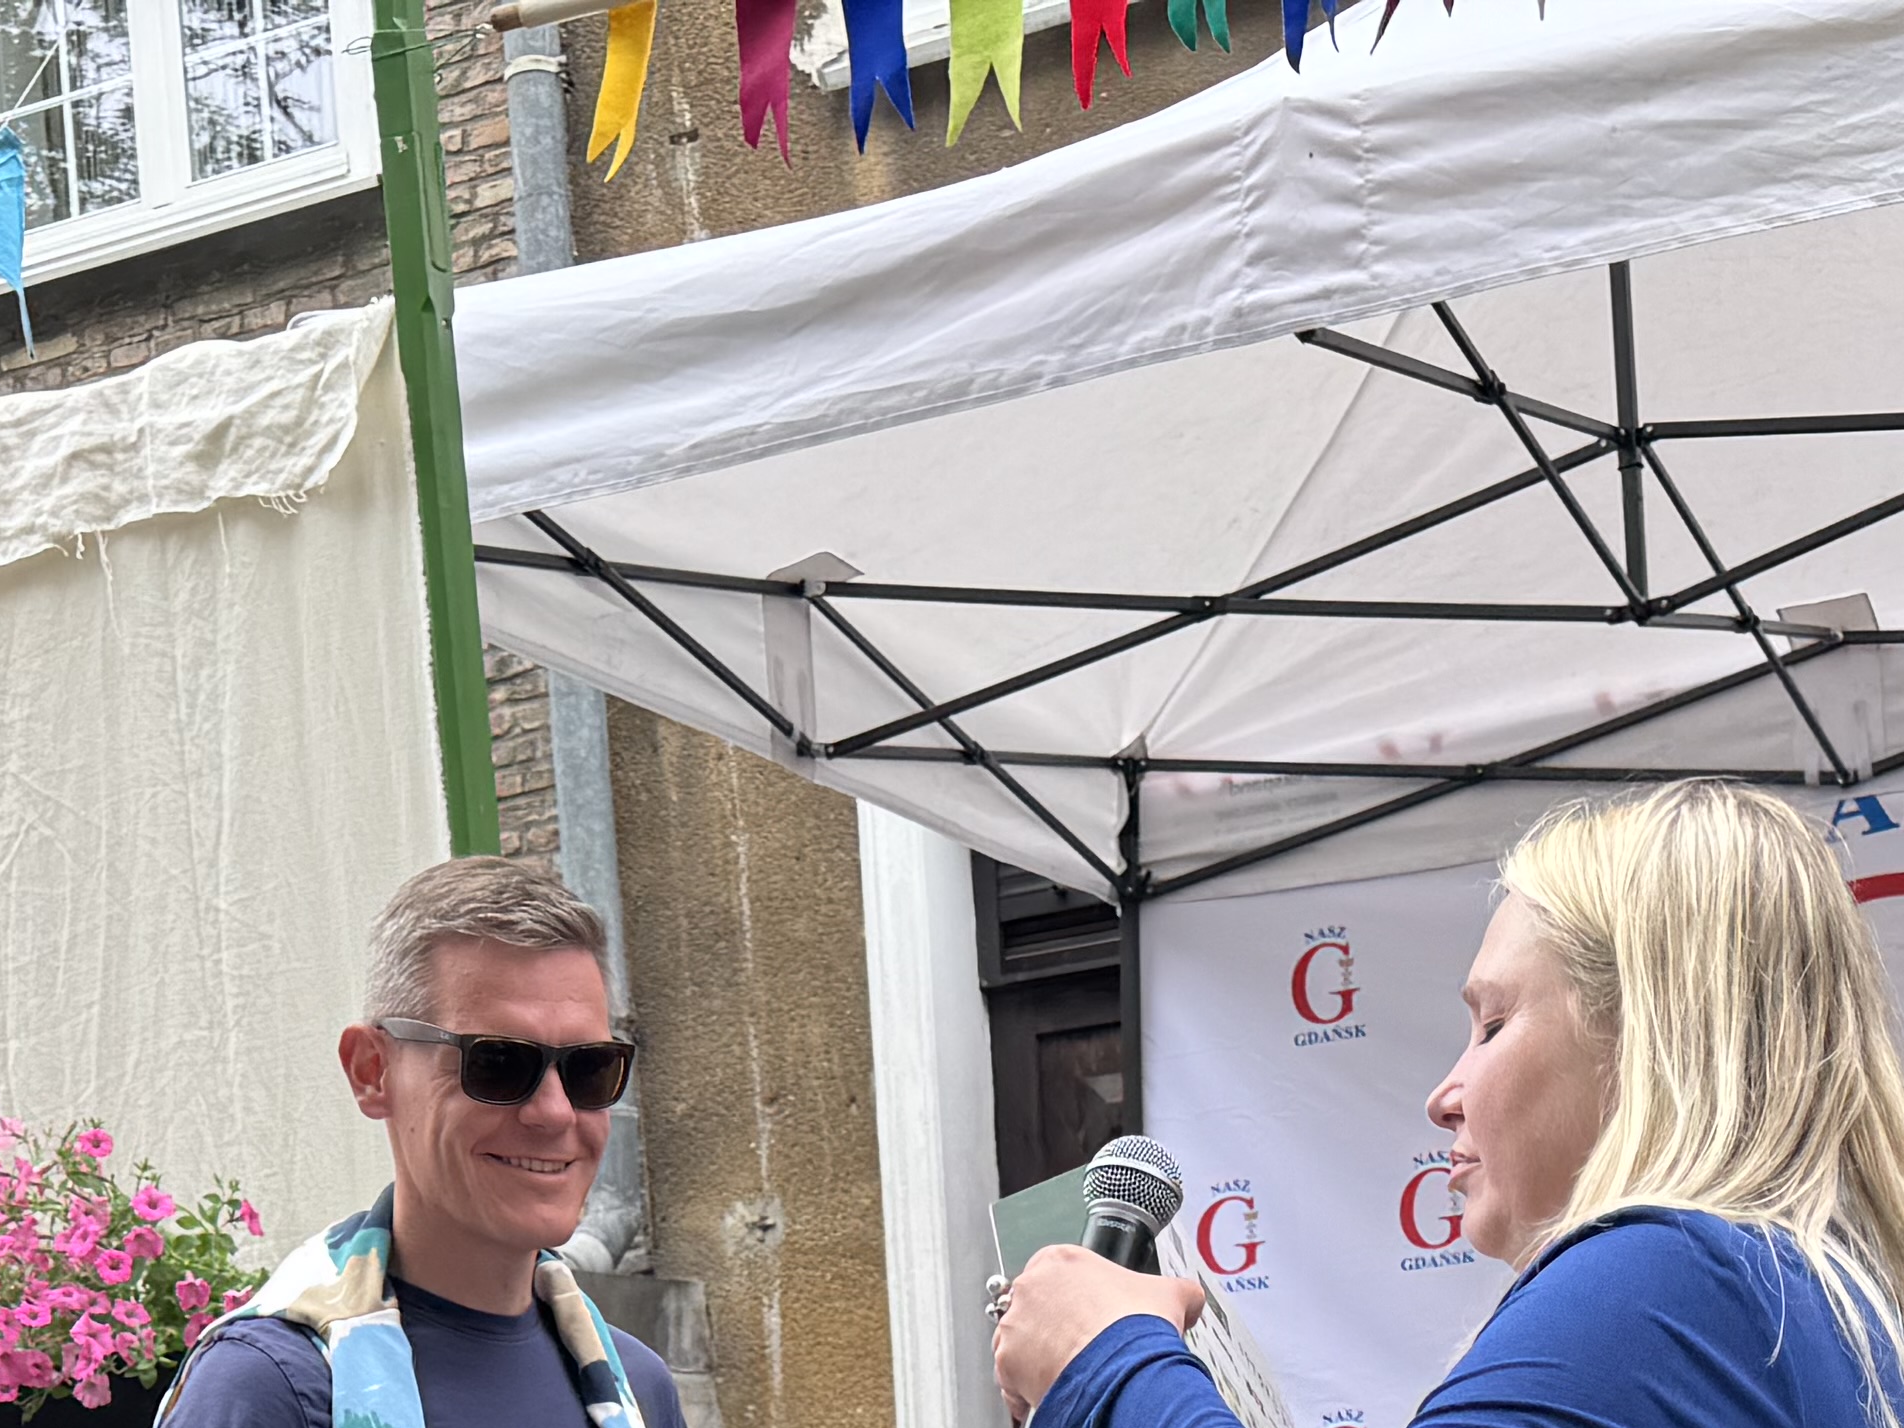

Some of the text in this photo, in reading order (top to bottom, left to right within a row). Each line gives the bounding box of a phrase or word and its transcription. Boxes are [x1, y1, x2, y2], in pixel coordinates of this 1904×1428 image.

[1303, 925, 1348, 945] NASZ
[1293, 1023, 1367, 1047] GDAŃSK
[1412, 1150, 1450, 1169] NAS
[1210, 1179, 1252, 1197] NASZ
[1399, 1247, 1476, 1271] GDAŃSK
[1221, 1275, 1269, 1293] AŃSK
[1322, 1408, 1364, 1427] NASZ
